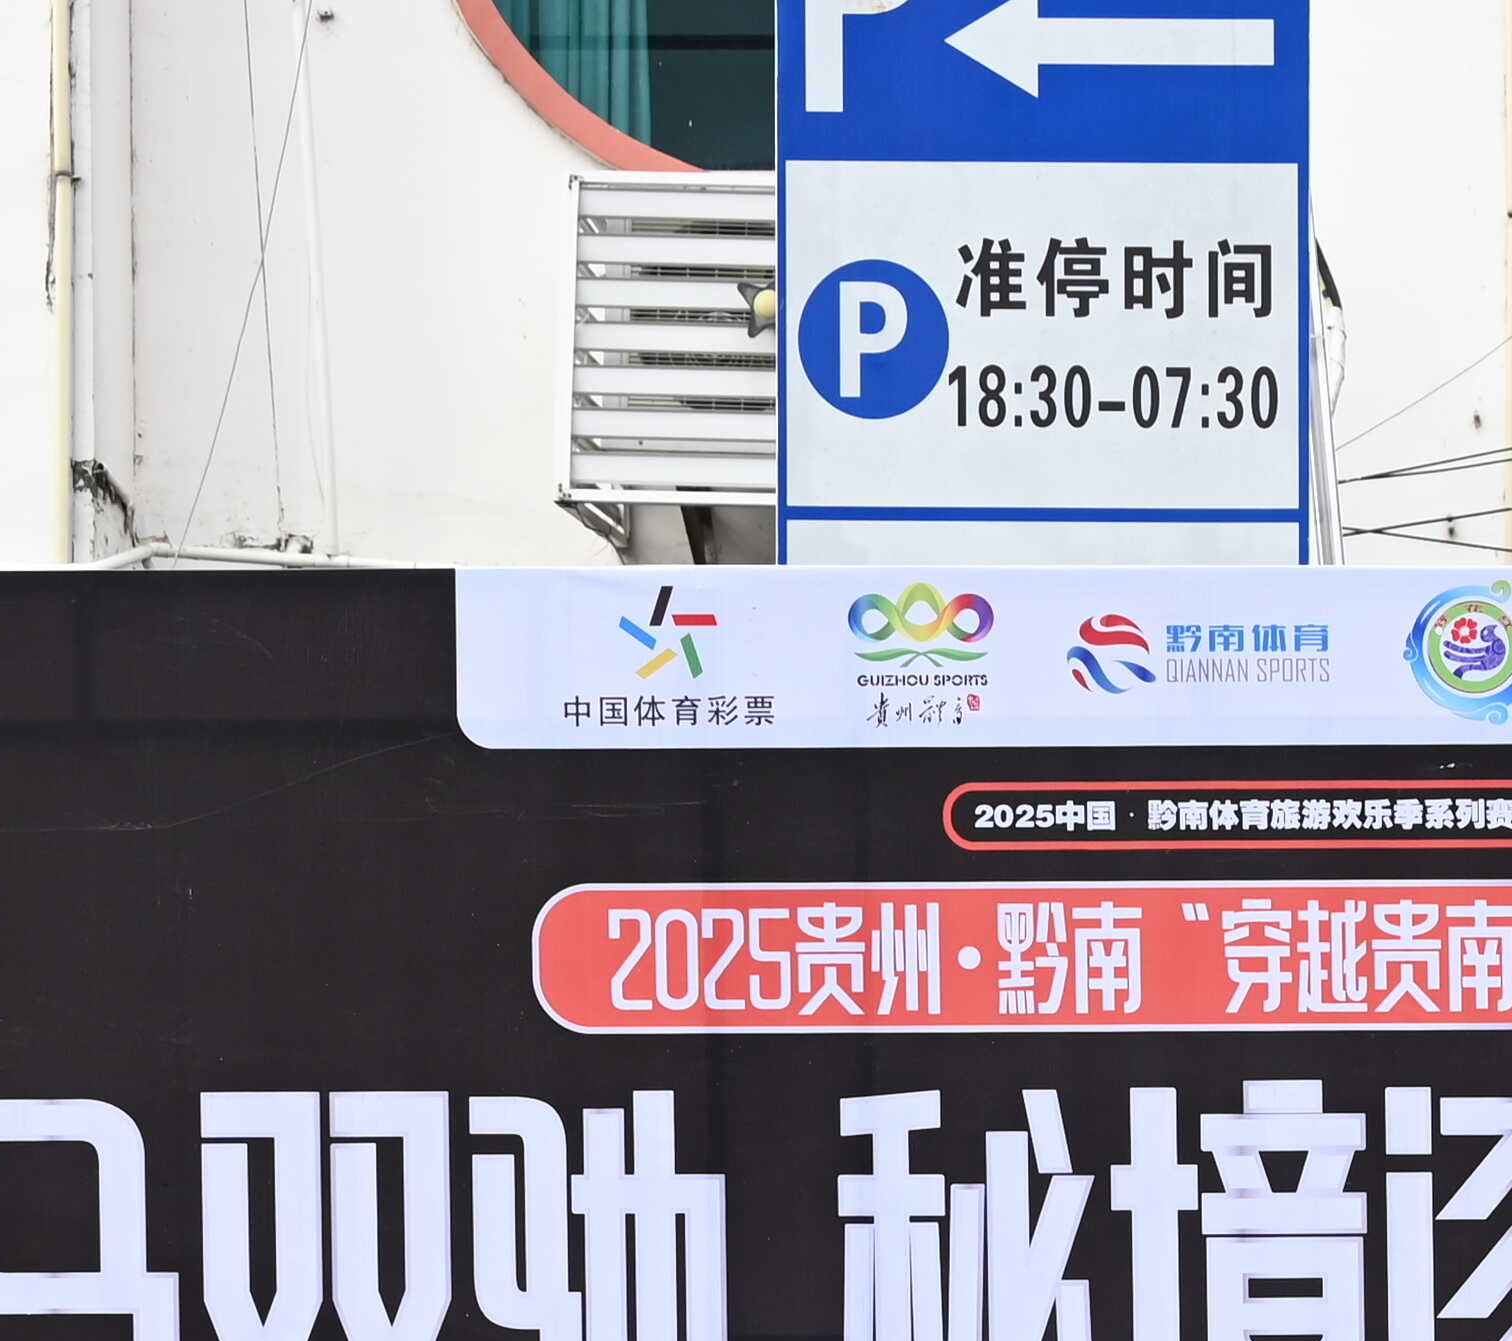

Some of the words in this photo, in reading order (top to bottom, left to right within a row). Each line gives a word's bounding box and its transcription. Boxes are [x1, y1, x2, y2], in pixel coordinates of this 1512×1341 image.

[955, 237, 1272, 319] 准停时间
[948, 364, 1278, 429] 18:30-07:30
[1165, 624, 1329, 652] 黔南体育
[856, 674, 929, 687] GUIZHOU
[934, 674, 988, 687] SPORTS
[1166, 658, 1248, 684] QIANNAN
[1256, 658, 1329, 684] SPORTS
[563, 695, 776, 728] 中国体育彩票
